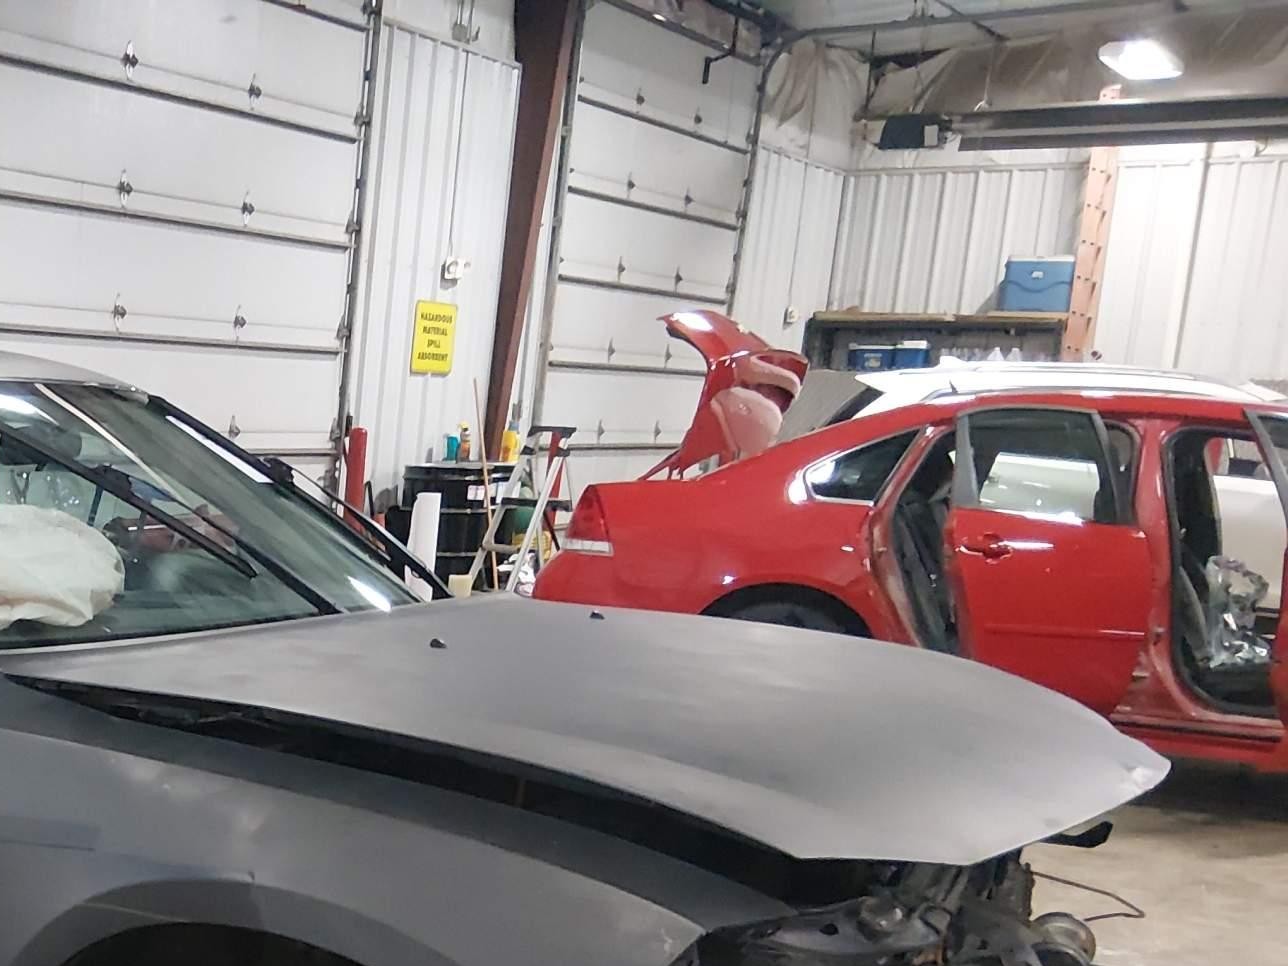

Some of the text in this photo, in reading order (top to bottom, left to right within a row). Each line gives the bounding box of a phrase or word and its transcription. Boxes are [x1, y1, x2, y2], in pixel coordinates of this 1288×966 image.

[420, 312, 453, 324] HAZARDOUS
[422, 326, 448, 336] MATERIAL
[426, 339, 441, 348] SPILL
[417, 352, 449, 362] ABSORBENT
